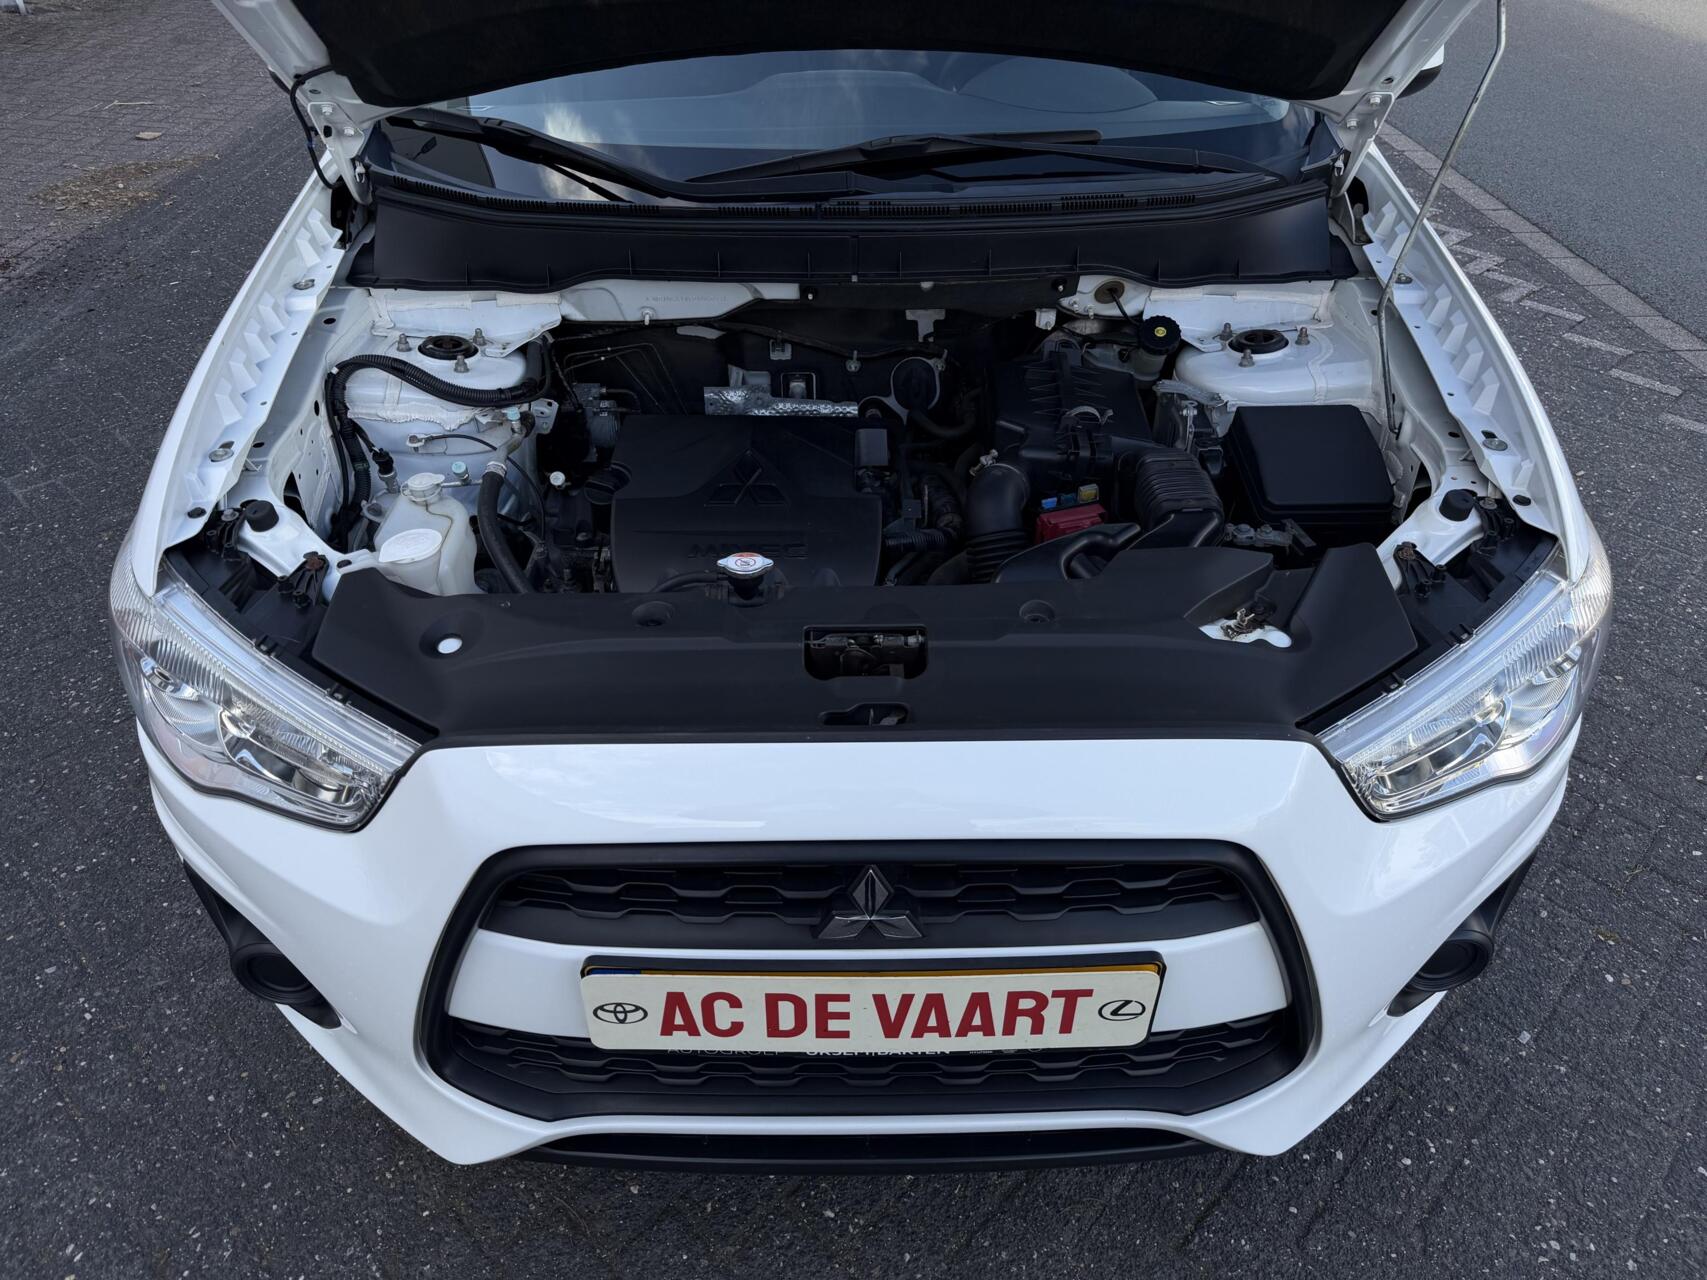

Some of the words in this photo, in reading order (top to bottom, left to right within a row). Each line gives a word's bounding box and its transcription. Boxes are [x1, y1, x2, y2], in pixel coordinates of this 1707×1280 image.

[660, 991, 745, 1038] AC
[764, 992, 850, 1039] DE
[873, 989, 1093, 1039] VAART
